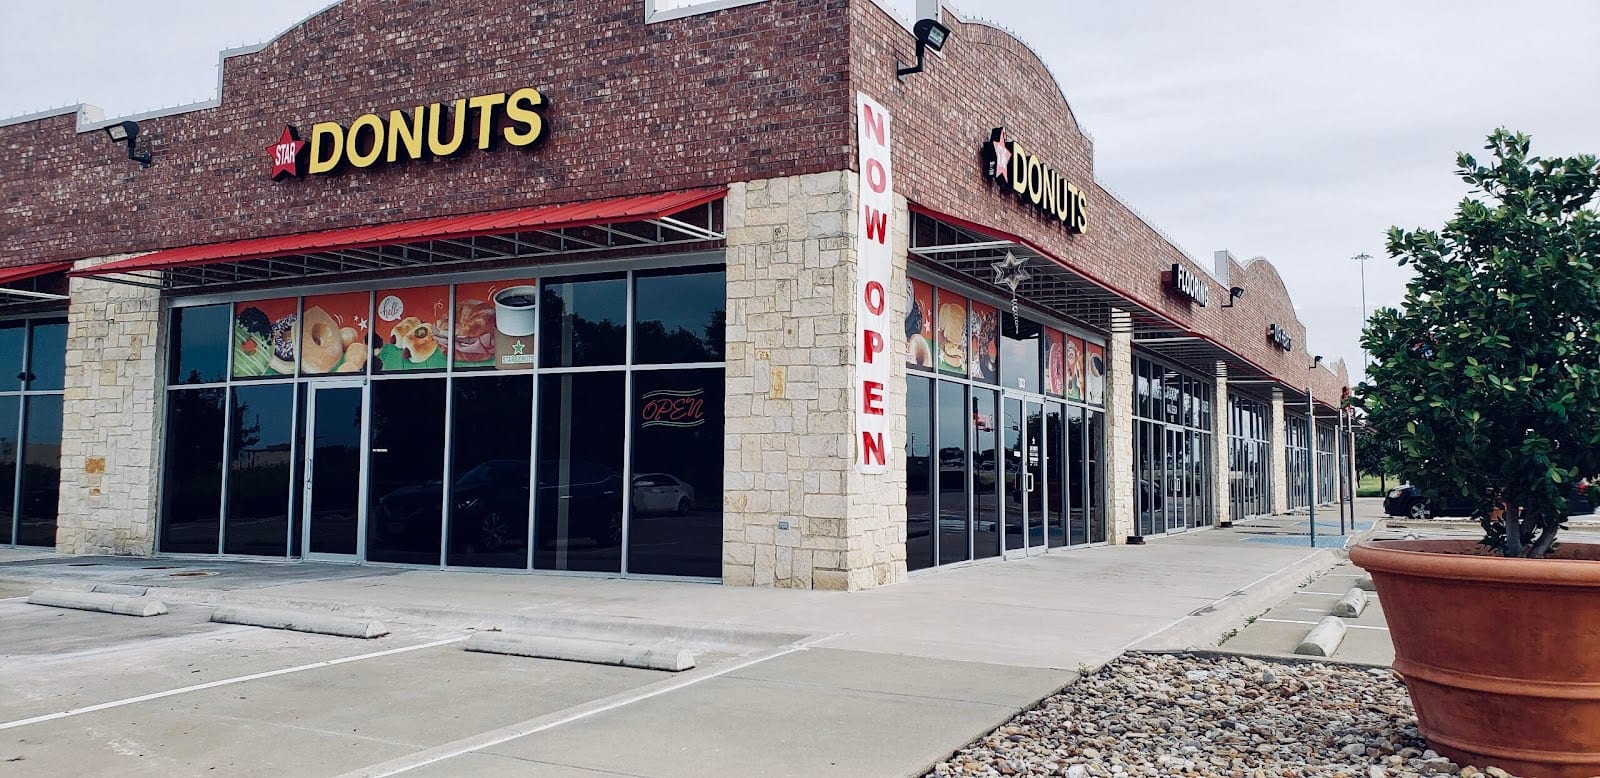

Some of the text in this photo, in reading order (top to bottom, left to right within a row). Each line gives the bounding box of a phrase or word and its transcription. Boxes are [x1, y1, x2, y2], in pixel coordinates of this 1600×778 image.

[275, 87, 542, 174] STAR DONUTS
[1012, 141, 1088, 234] DONUTS
[863, 103, 888, 466] NOW OPEN
[1177, 264, 1209, 308] FLOORING
[642, 398, 704, 421] OPEN
